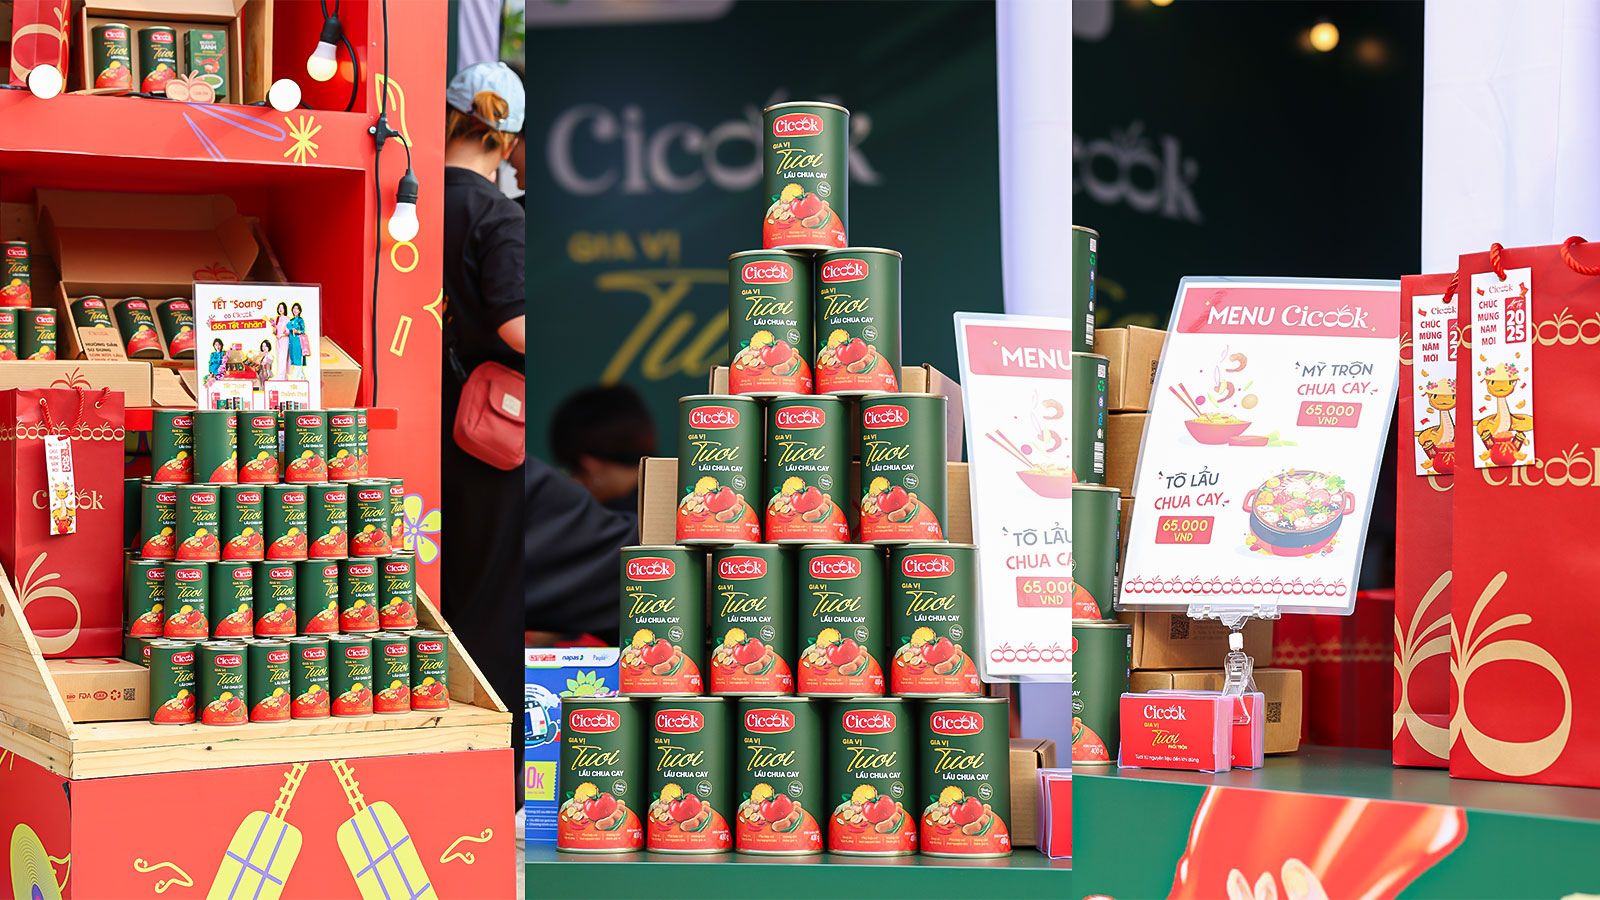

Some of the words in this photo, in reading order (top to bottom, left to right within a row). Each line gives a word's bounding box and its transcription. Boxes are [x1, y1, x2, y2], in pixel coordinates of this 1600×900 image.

[776, 118, 818, 132] Cicook
[745, 265, 788, 279] Cicook
[823, 264, 864, 278] Cicook
[1208, 306, 1275, 326] MENU
[1282, 304, 1368, 328] Cicook
[1506, 309, 1525, 326] 20
[1506, 325, 1525, 342] 25
[1332, 361, 1372, 378] TRỘN
[1298, 384, 1336, 396] CHUA
[1342, 382, 1371, 394] CAY
[692, 410, 734, 424] Cicook
[778, 410, 820, 424] Cicook
[865, 409, 904, 424] Cicook
[1306, 405, 1354, 417] 65.000
[1318, 416, 1338, 425] VND
[1166, 472, 1188, 488] TÔ
[1190, 466, 1219, 486] LẨU
[1154, 496, 1190, 510] CHUA
[1196, 492, 1224, 506] CAY
[1162, 519, 1208, 532] 65.000
[1013, 528, 1038, 546] TÔ
[1174, 532, 1193, 542] VND
[628, 562, 670, 576] Cicook
[720, 561, 762, 575] Cicook
[812, 560, 856, 574] Cicook
[905, 559, 950, 574] Cicook
[1006, 554, 1051, 570] CHUA
[1040, 595, 1064, 604] VND
[1144, 704, 1186, 720] Cicook
[572, 714, 616, 728] Cicook
[657, 714, 700, 728] Cicook
[747, 714, 790, 728] Cicook
[846, 713, 892, 729] Cicook
[934, 714, 979, 730] Cicook
